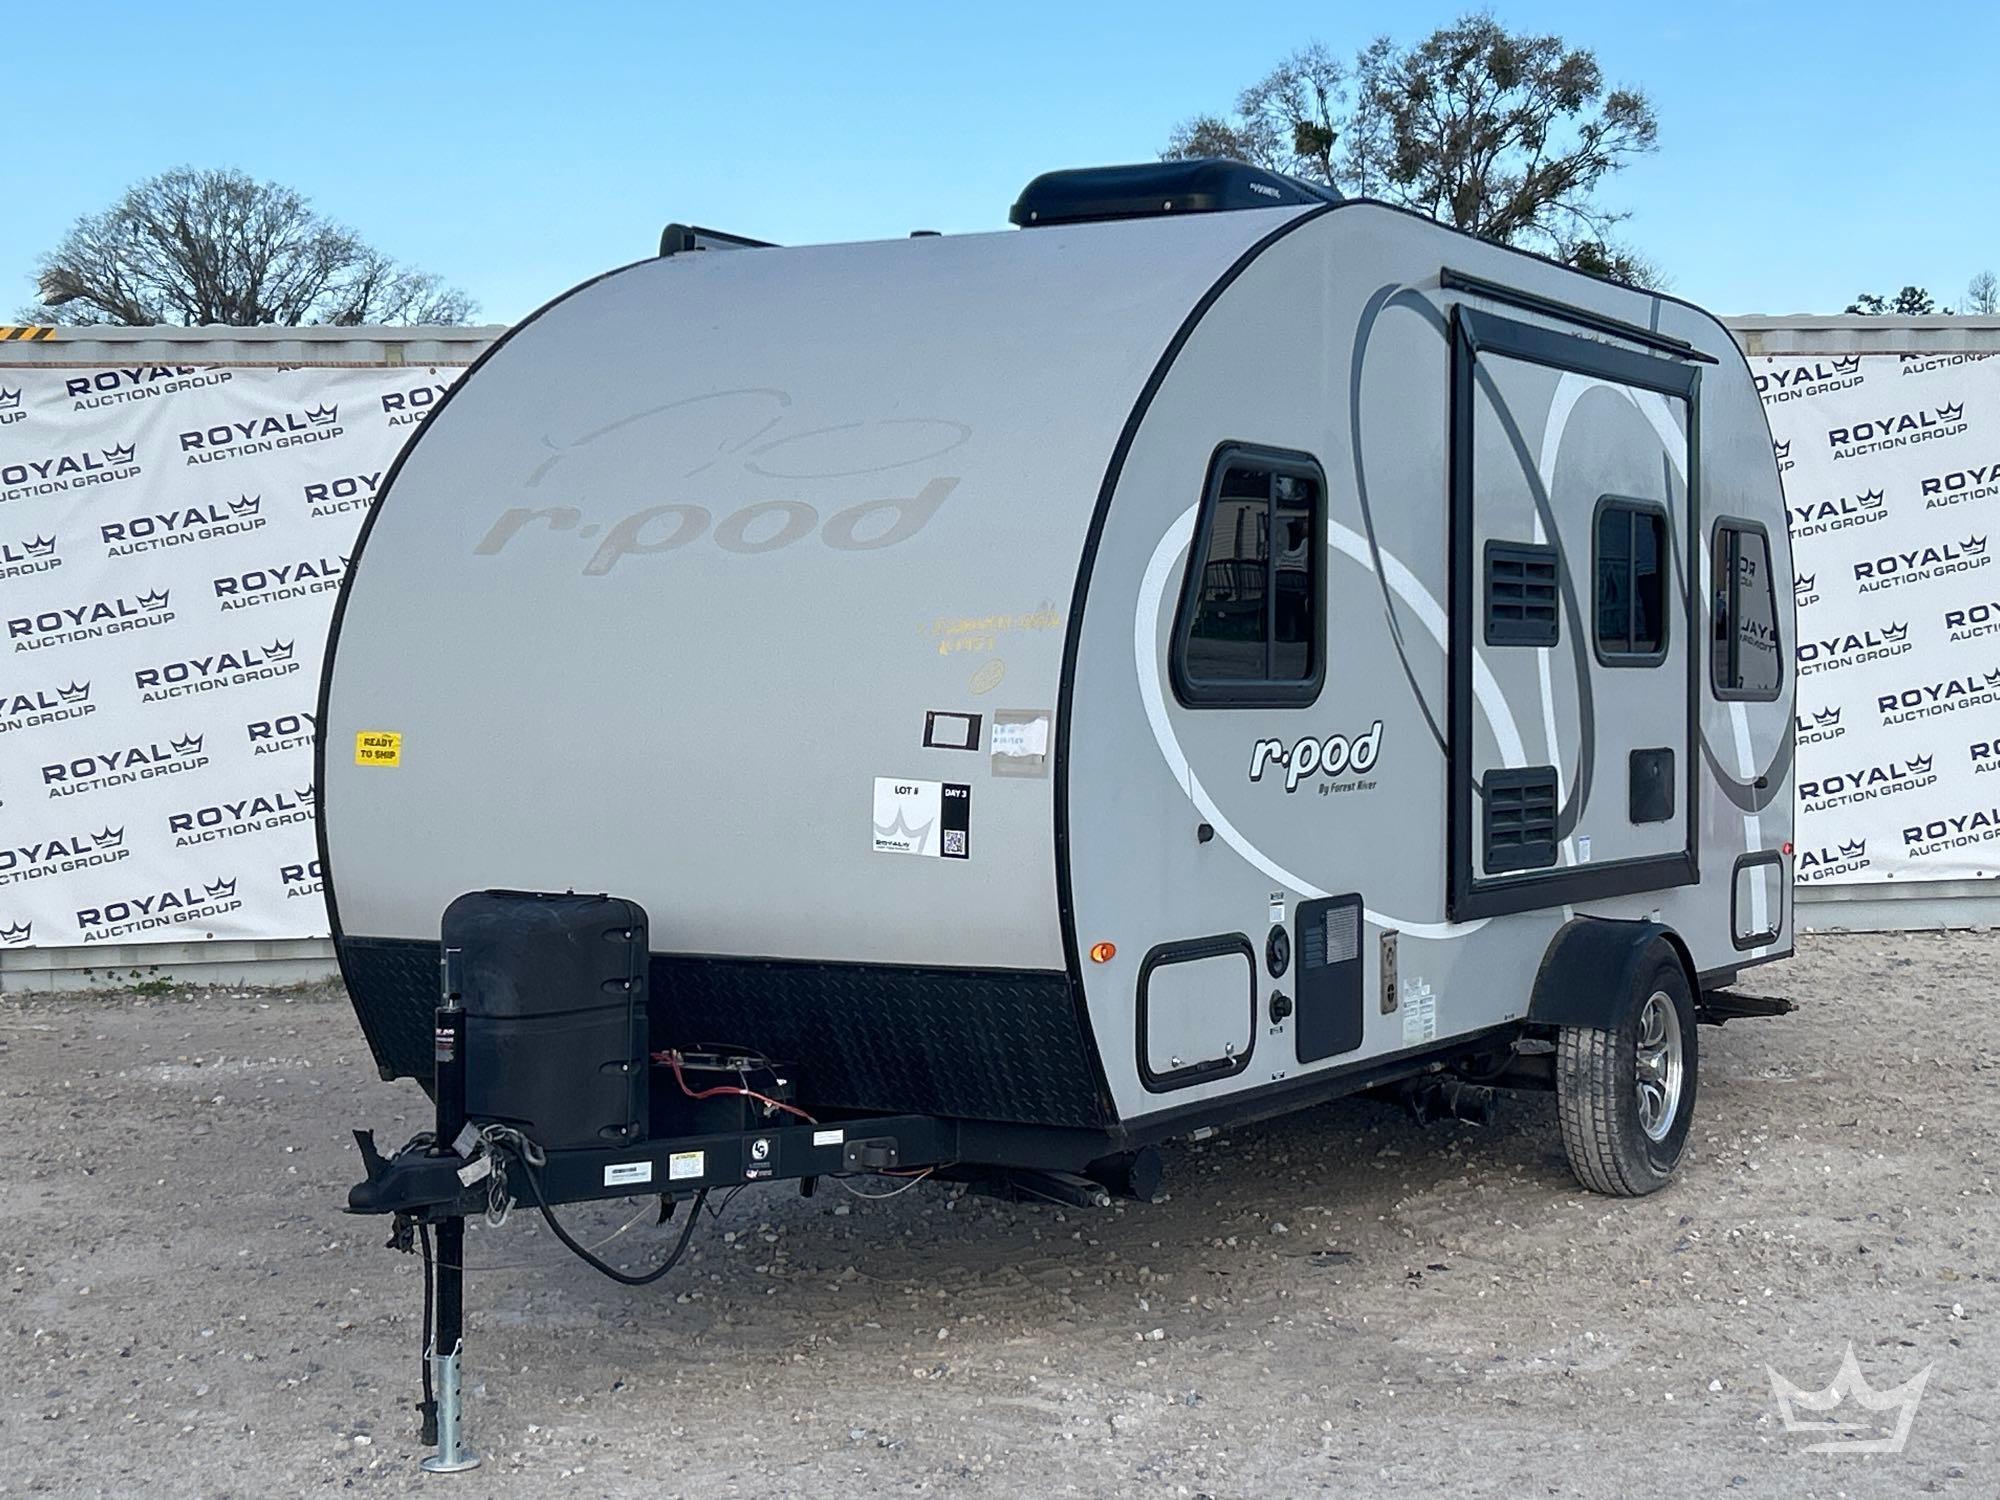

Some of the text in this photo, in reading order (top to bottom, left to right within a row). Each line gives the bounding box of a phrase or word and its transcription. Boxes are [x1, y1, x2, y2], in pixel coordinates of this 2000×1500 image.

[73, 371, 233, 412] AUCTION GROUP
[1753, 363, 1833, 393] OYAL
[1762, 375, 1865, 405] TION GROUP
[179, 413, 307, 451] ROYAL
[186, 427, 344, 466] AUCTION GROUP
[1828, 410, 1937, 448] ROYAL
[1833, 423, 1969, 460] AUCTION GROUP
[2, 452, 104, 485] OYAL
[72, 466, 142, 488] GROUP
[1920, 463, 2000, 497] ROYA
[304, 472, 382, 504] ROY
[1926, 486, 1999, 510] AUCTION
[100, 504, 230, 545] ROYAL
[107, 518, 267, 558] AUCTION GROUP
[1789, 510, 1889, 539] TION GROUP
[213, 558, 341, 598] ROYAL
[1853, 543, 1961, 581] ROYAL
[1858, 555, 1992, 595] AUCTION GROUP
[220, 586, 307, 612] AUCTION
[8, 598, 139, 639] ROYAL
[15, 611, 176, 654] AUCTION GROUP
[1795, 631, 1882, 662] OYAL
[1798, 642, 1913, 676] CTION GROUP
[134, 649, 264, 689] ROYAL
[142, 662, 301, 704] AUCTION GROUP
[1877, 676, 1985, 714] ROYAL
[1882, 690, 2000, 727] AUCTION GROU
[26, 704, 97, 728] GROUP
[360, 749, 396, 760] TO SHIP
[363, 737, 394, 748] READY
[1797, 727, 1846, 746] ROUP
[41, 743, 172, 785] ROYAL
[49, 756, 210, 799] AUCTION GROUP
[1798, 763, 1907, 801] ROYAL
[894, 785, 912, 796] LOT
[944, 788, 968, 798] DAY 3
[1330, 781, 1355, 793] Forest
[1356, 780, 1377, 791] River
[1803, 774, 1938, 814] AUCTION GROUP
[168, 793, 297, 834] ROYAL
[175, 808, 315, 848] AUCTION GROU
[0, 836, 93, 870] OYAL
[61, 848, 131, 872] GROUP
[1908, 834, 1980, 858] AUCTION
[1812, 859, 1871, 880] GROUP
[76, 886, 206, 929] ROYAL
[83, 900, 243, 943] AUCTION GROUP
